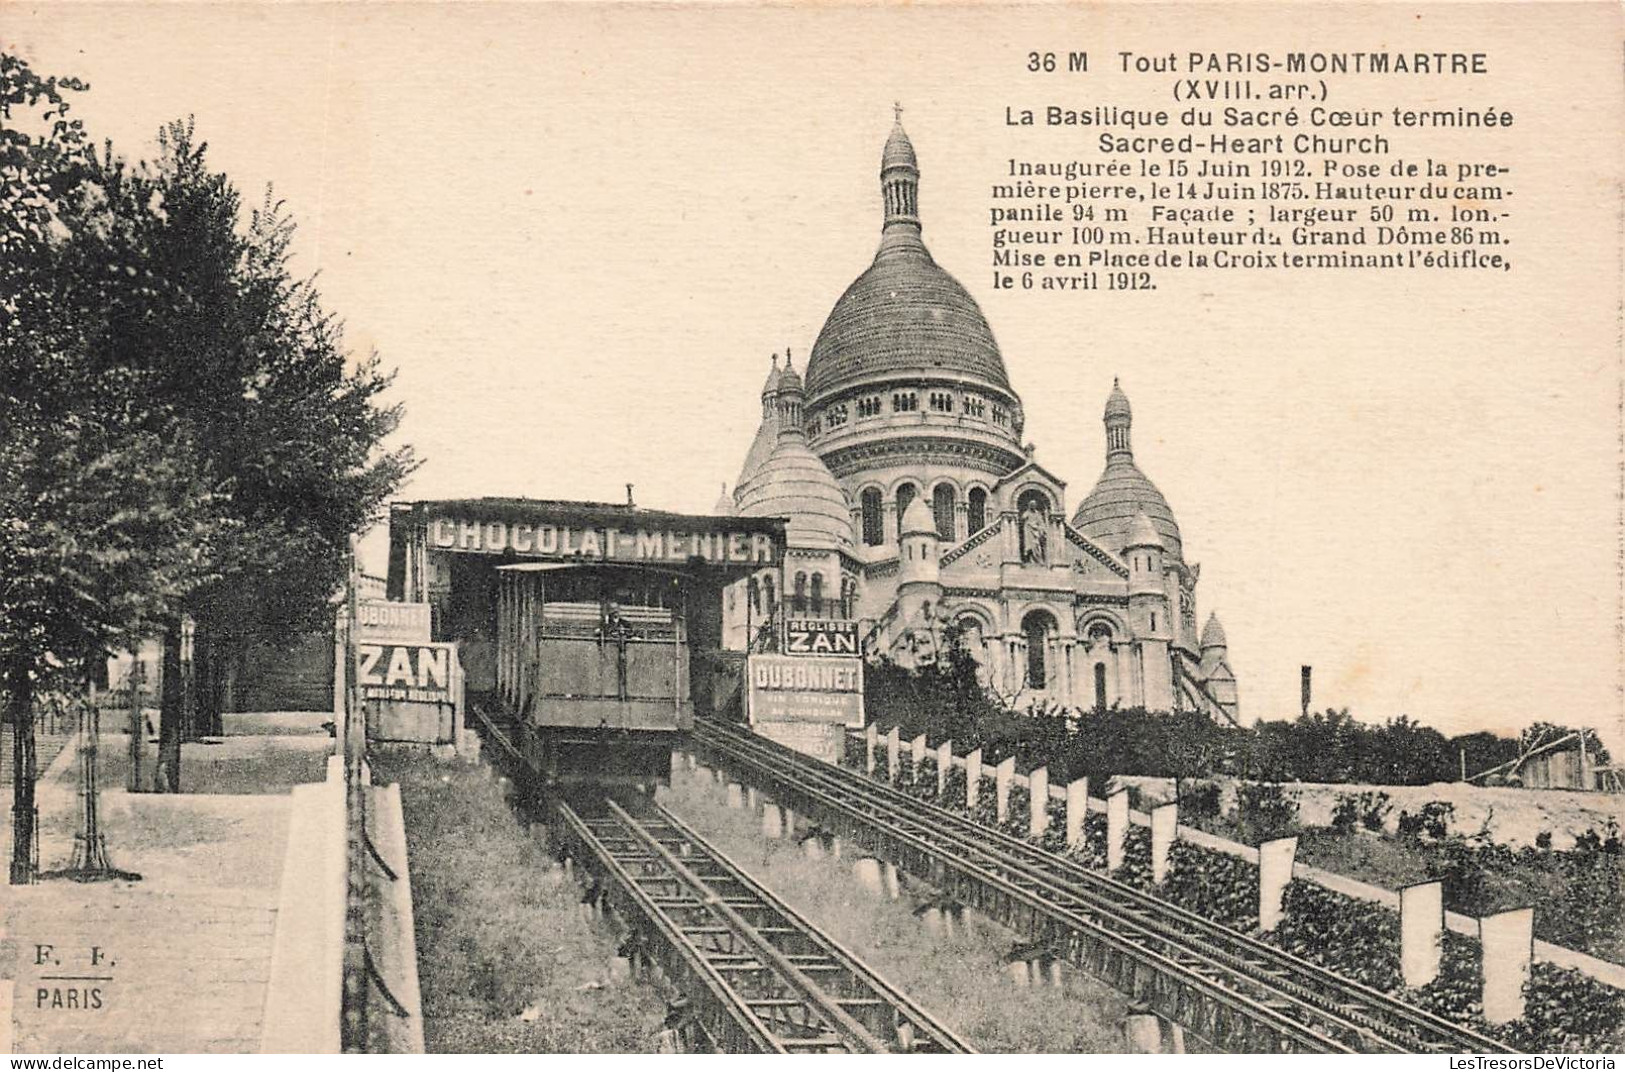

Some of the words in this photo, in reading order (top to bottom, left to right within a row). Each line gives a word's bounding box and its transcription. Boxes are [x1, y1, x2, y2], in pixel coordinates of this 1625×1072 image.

[433, 517, 774, 563] CHOCOLAT-MENIER
[788, 631, 856, 652] ZAN
[357, 645, 447, 689] ZAN
[756, 664, 859, 693] DUBONNET
